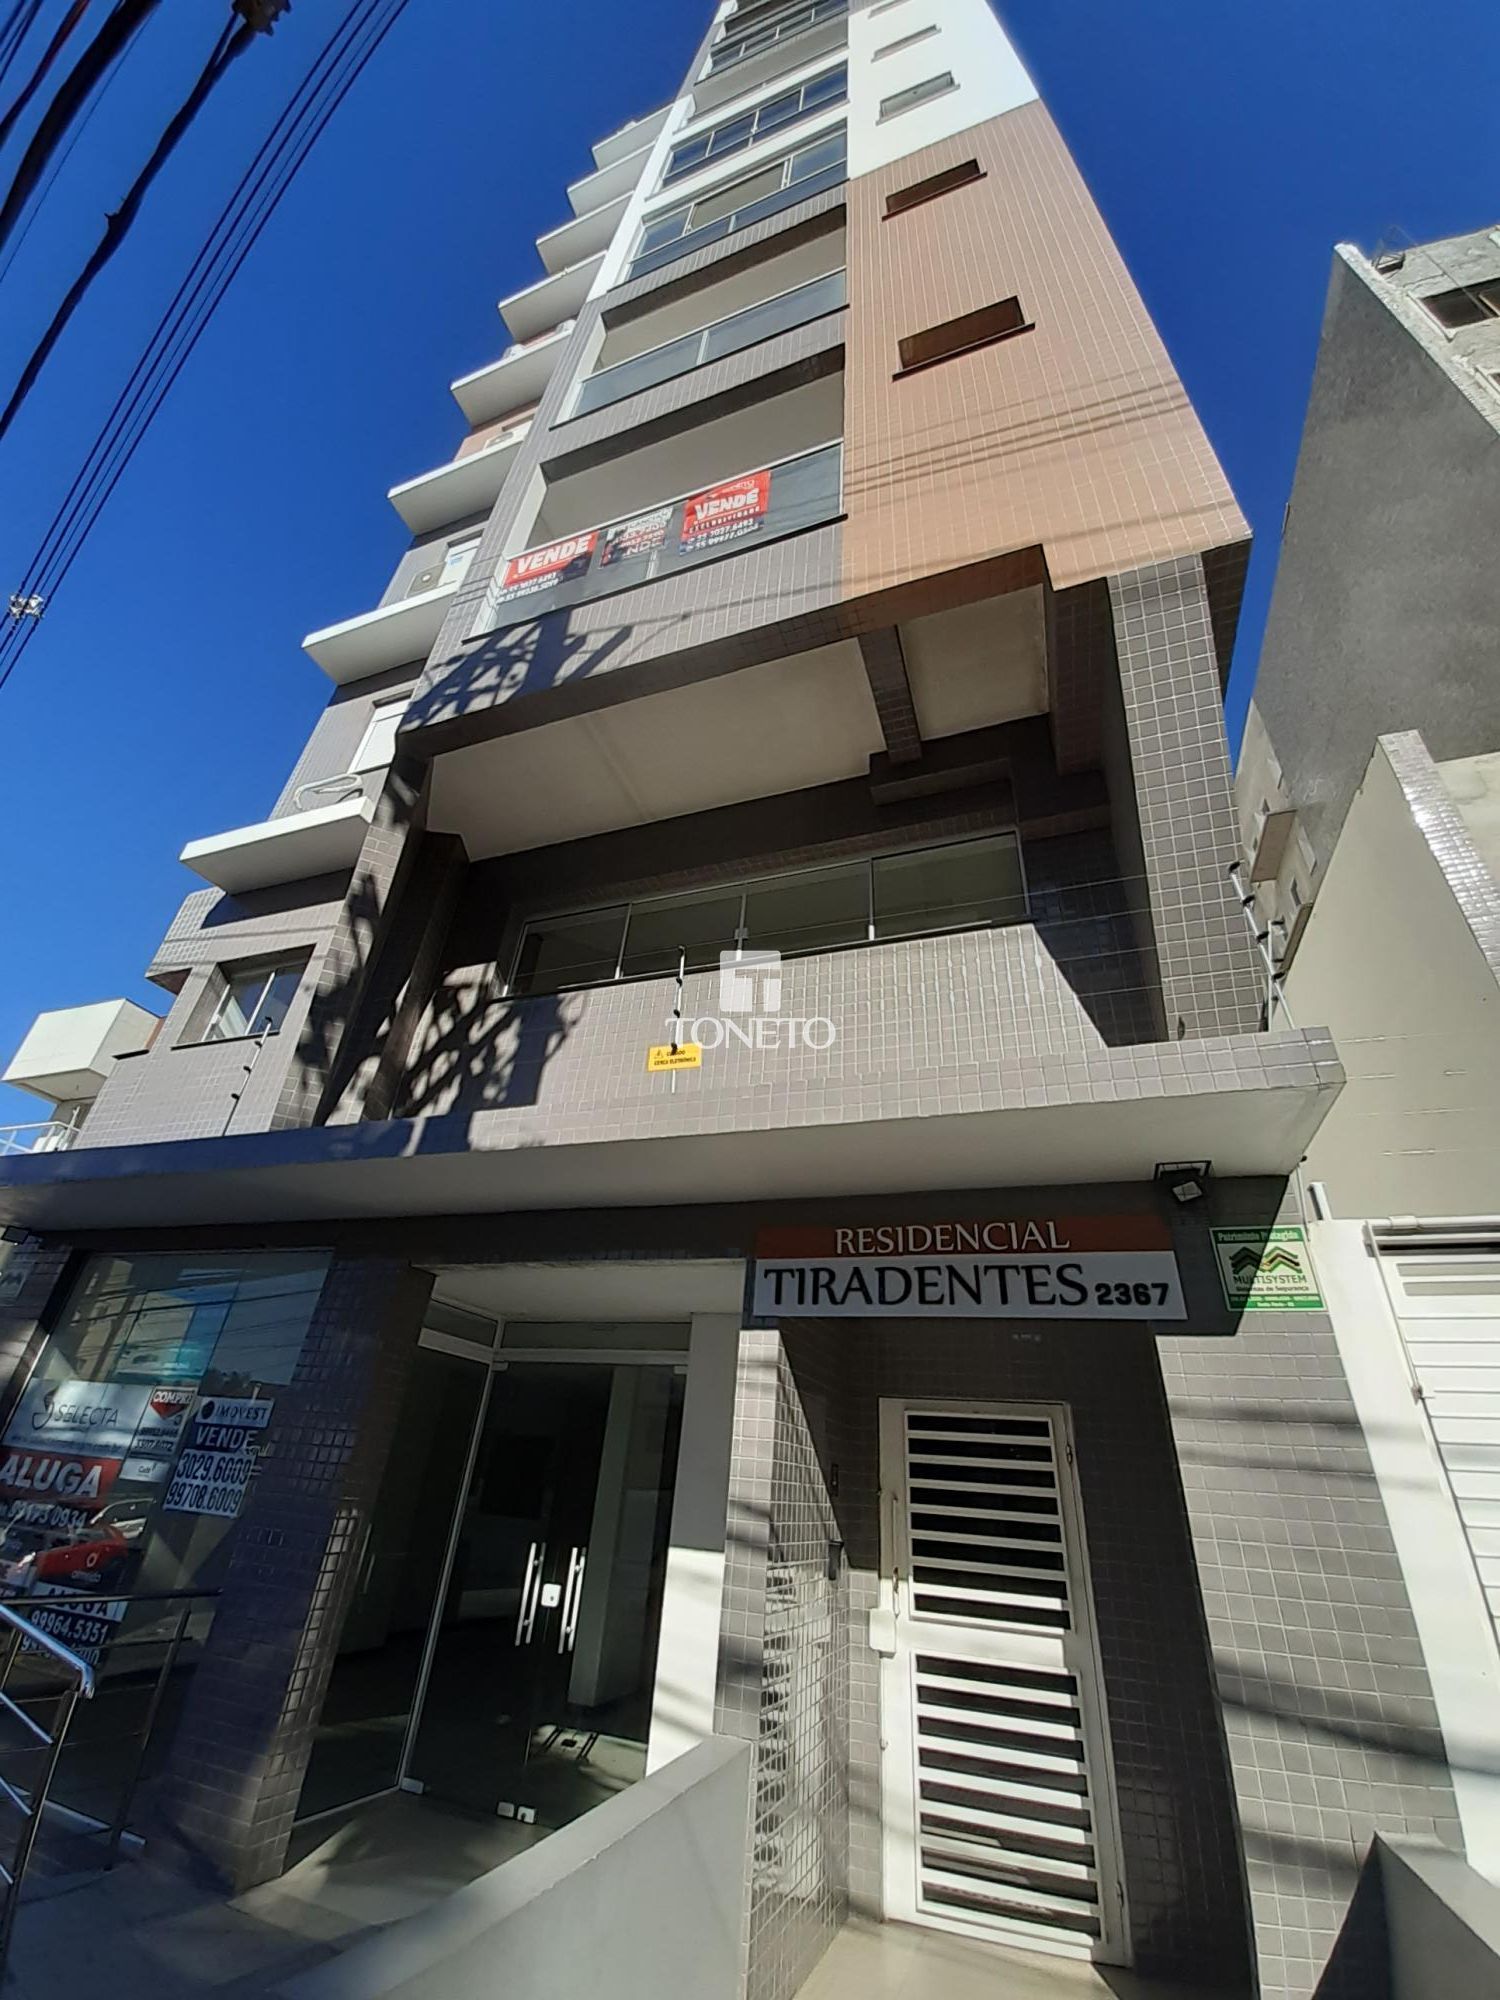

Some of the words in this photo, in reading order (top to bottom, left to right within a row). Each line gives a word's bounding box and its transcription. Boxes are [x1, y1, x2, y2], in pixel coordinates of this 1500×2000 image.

[694, 487, 760, 520] VENDE
[517, 535, 592, 574] VENDE
[835, 1221, 1070, 1255] RESIDENCIAL
[763, 1263, 1089, 1307] TIRADENTES
[1095, 1282, 1169, 1306] 2367
[54, 1403, 119, 1427] SELECTA
[215, 1404, 269, 1420] IMOVEST
[196, 1425, 259, 1450] VENDE
[0, 1454, 103, 1499] ALUGA
[176, 1453, 250, 1485] 3029.6009
[168, 1484, 241, 1514] 99708.6009
